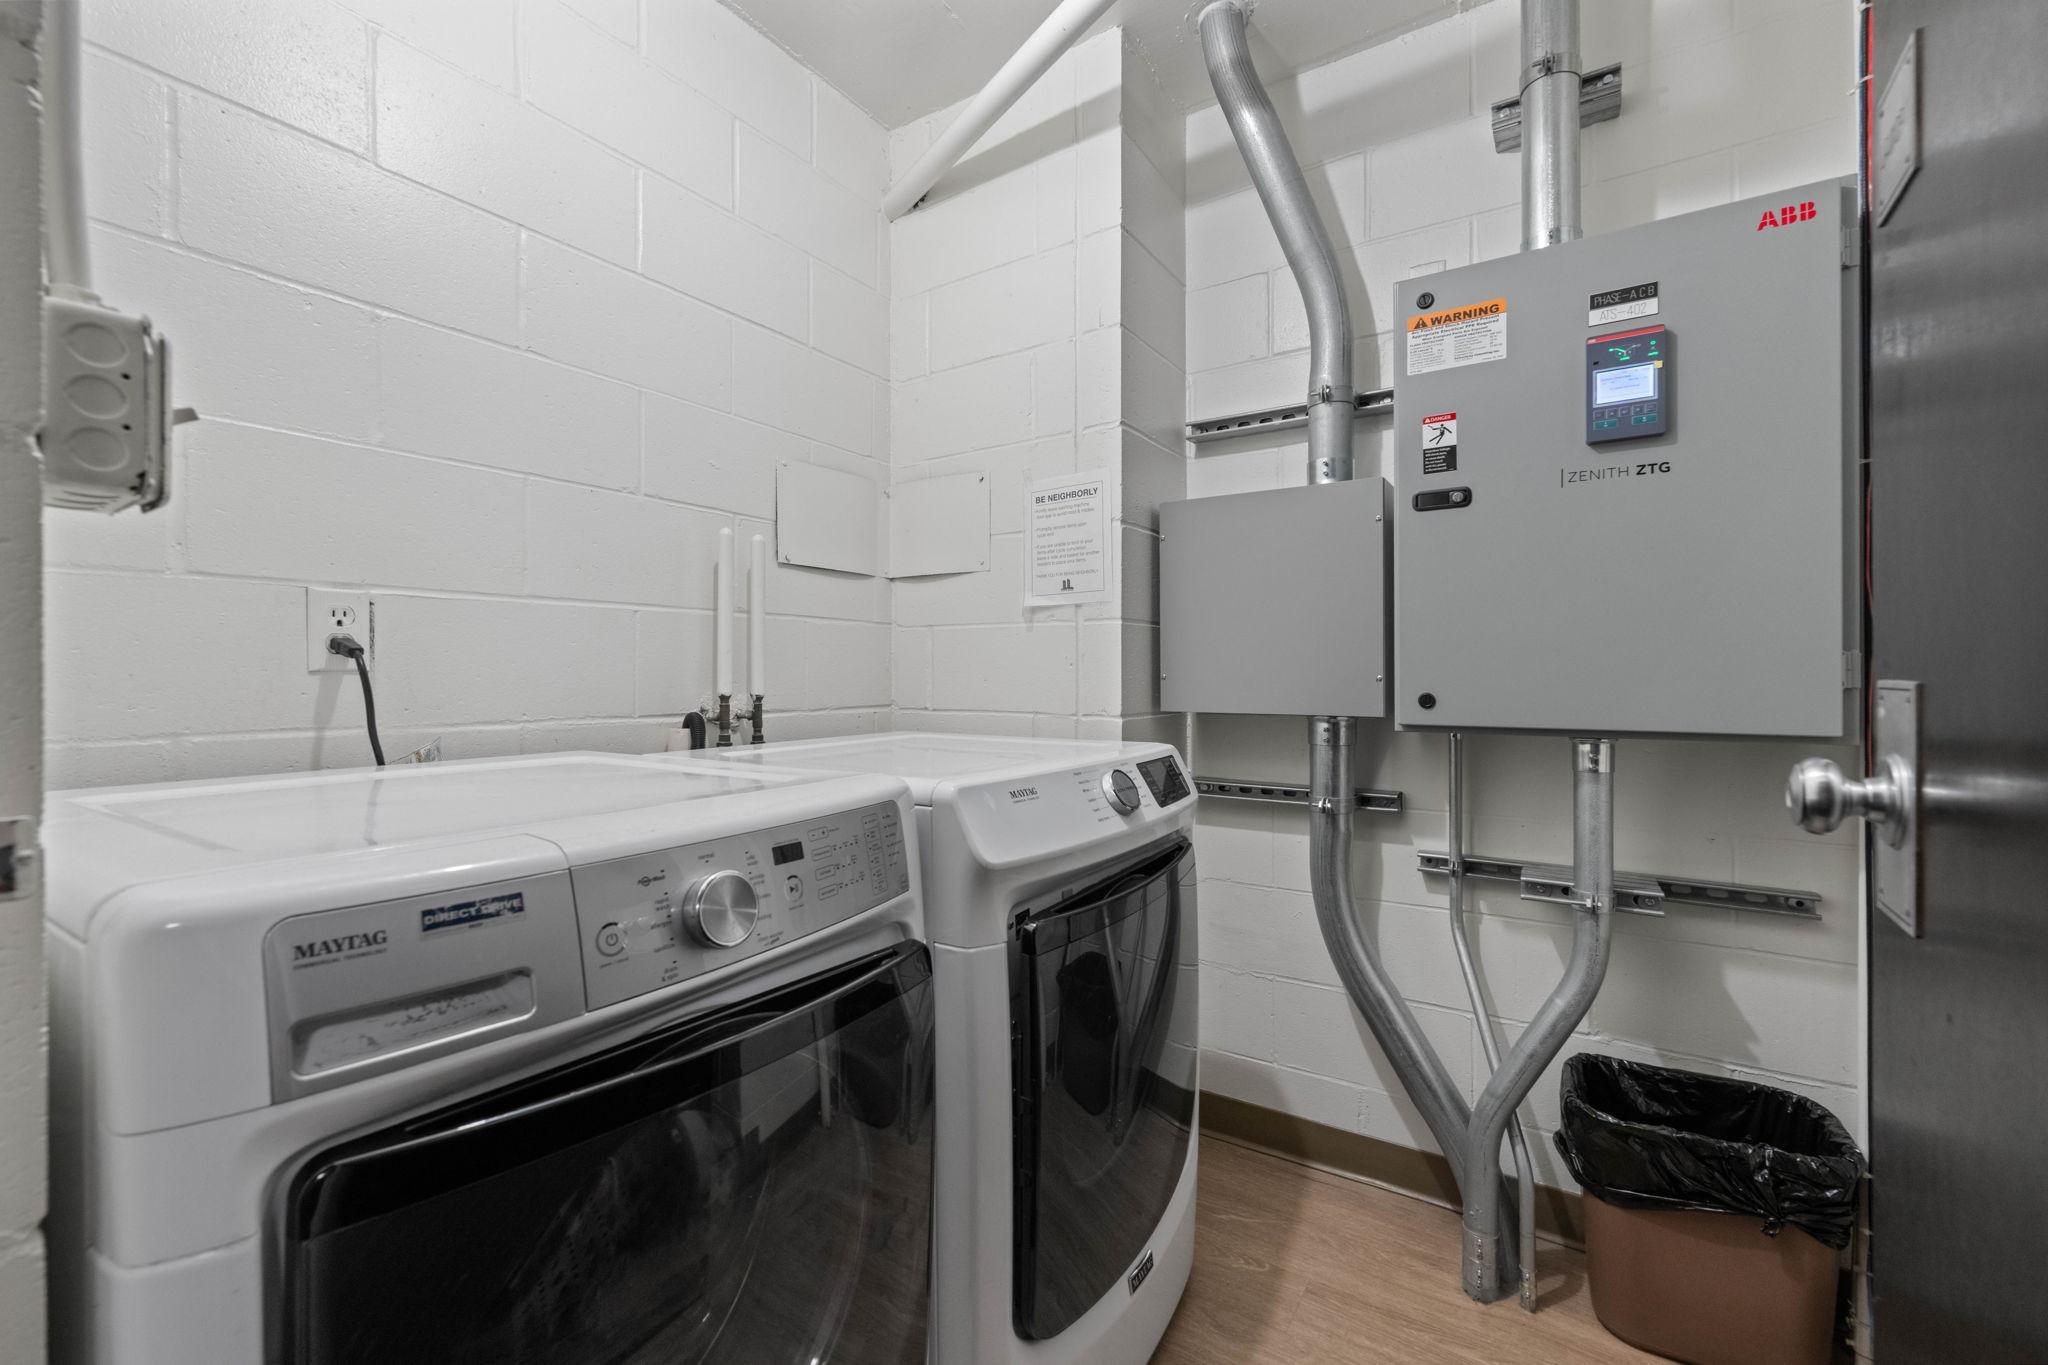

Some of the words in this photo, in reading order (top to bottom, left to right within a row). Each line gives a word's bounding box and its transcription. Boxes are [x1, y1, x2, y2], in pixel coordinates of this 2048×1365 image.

[1757, 201, 1817, 231] ABB
[1430, 304, 1500, 326] WARNING
[1568, 466, 1629, 483] ZENITH
[1636, 462, 1671, 476] ZTG
[1035, 496, 1046, 504] BE
[1047, 487, 1098, 502] NEIGHBORLY
[1009, 787, 1038, 799] MAYTAG
[424, 907, 478, 925] DIRECT
[293, 930, 388, 961] MAYTAG
